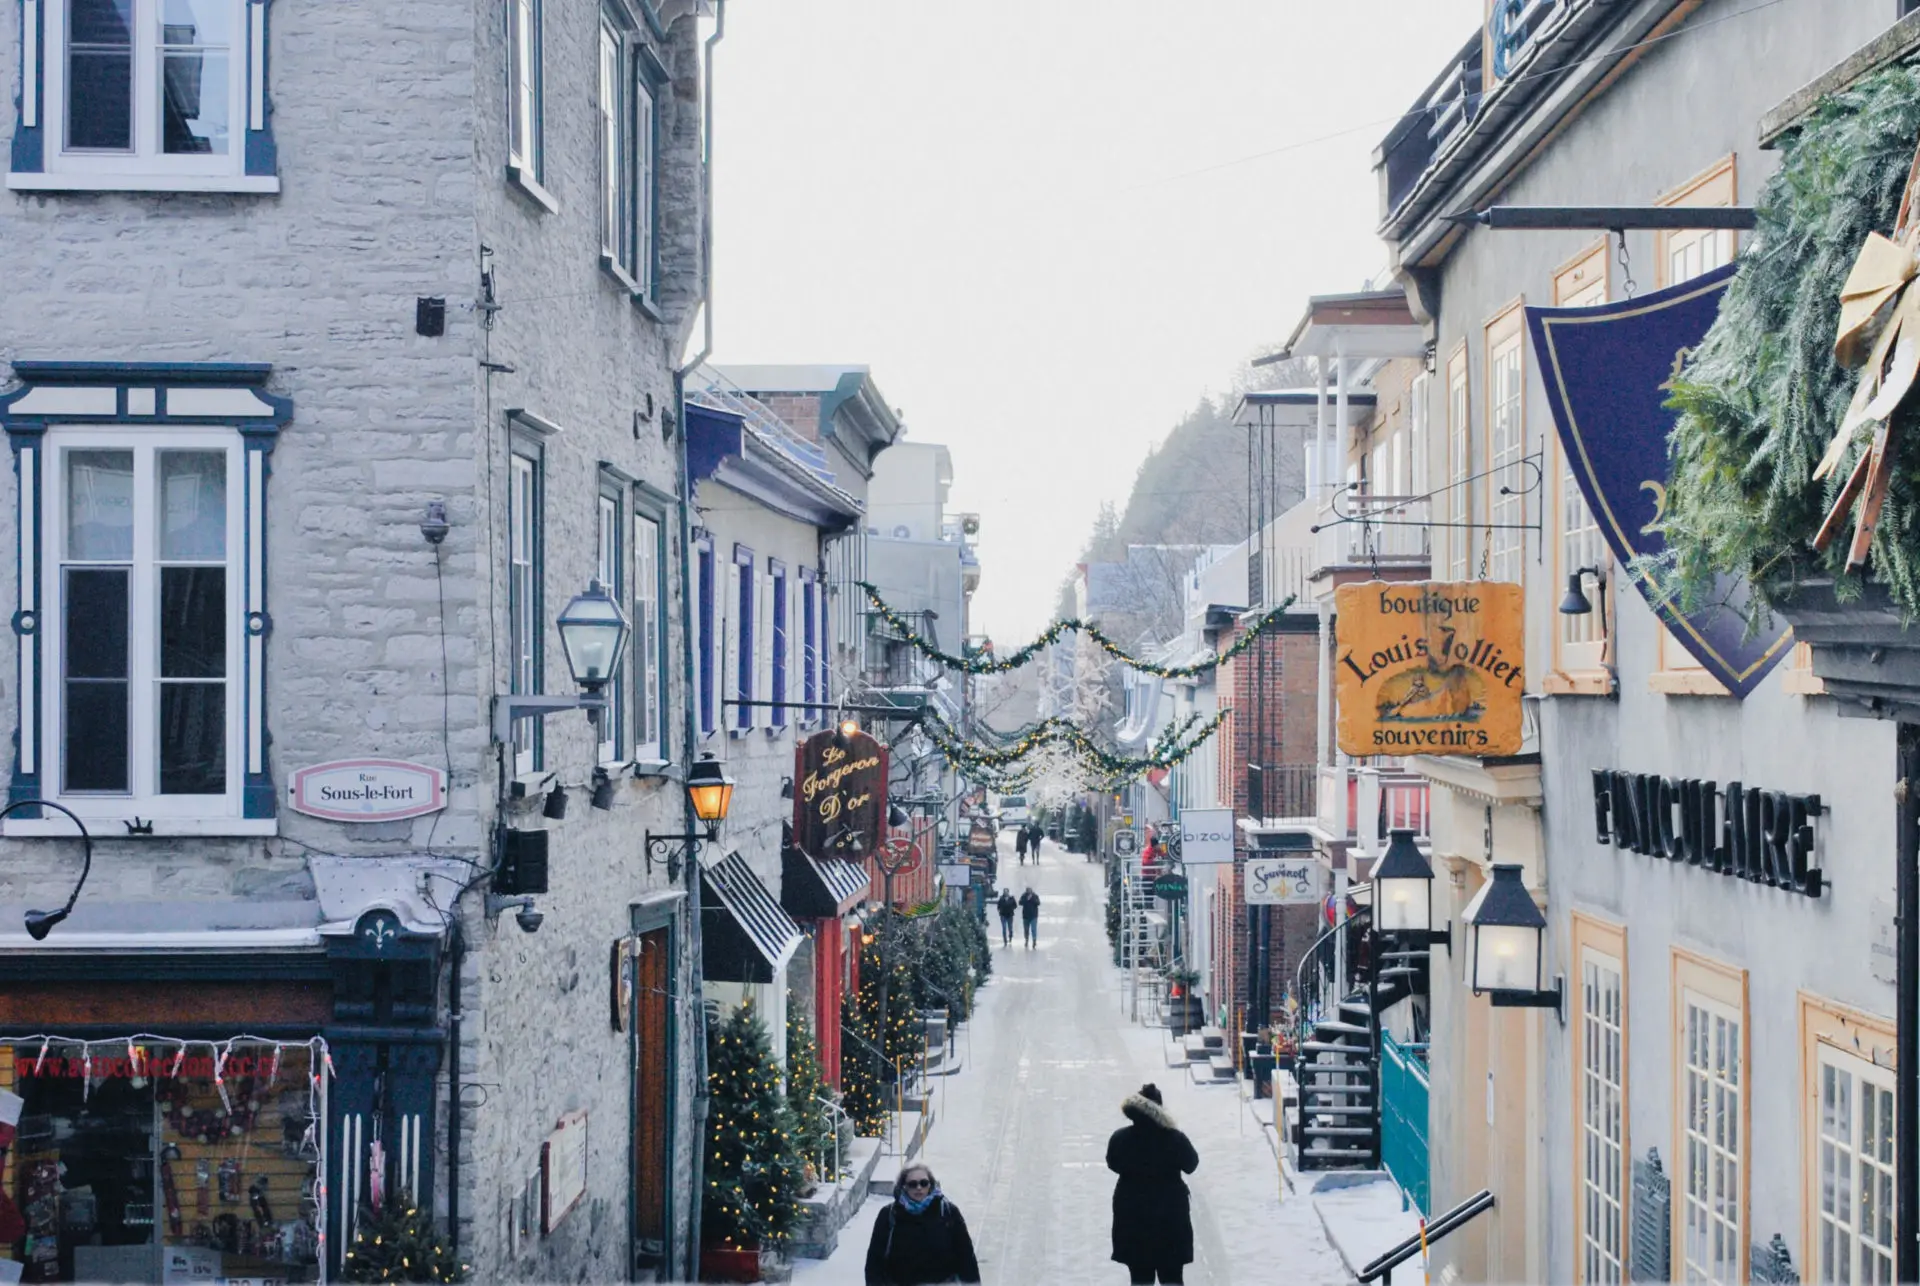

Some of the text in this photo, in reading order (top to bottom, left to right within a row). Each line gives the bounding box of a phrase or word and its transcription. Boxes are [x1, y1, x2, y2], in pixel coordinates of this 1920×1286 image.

[1380, 586, 1480, 620] boutique
[1340, 626, 1522, 688] Louis Jolliet
[1373, 723, 1488, 749] souvenirs
[822, 746, 846, 767] Le
[359, 773, 377, 782] Rue
[802, 755, 879, 802] Forgeron
[321, 785, 413, 801] Sous-le-Fort
[1183, 824, 1231, 842] bizou
